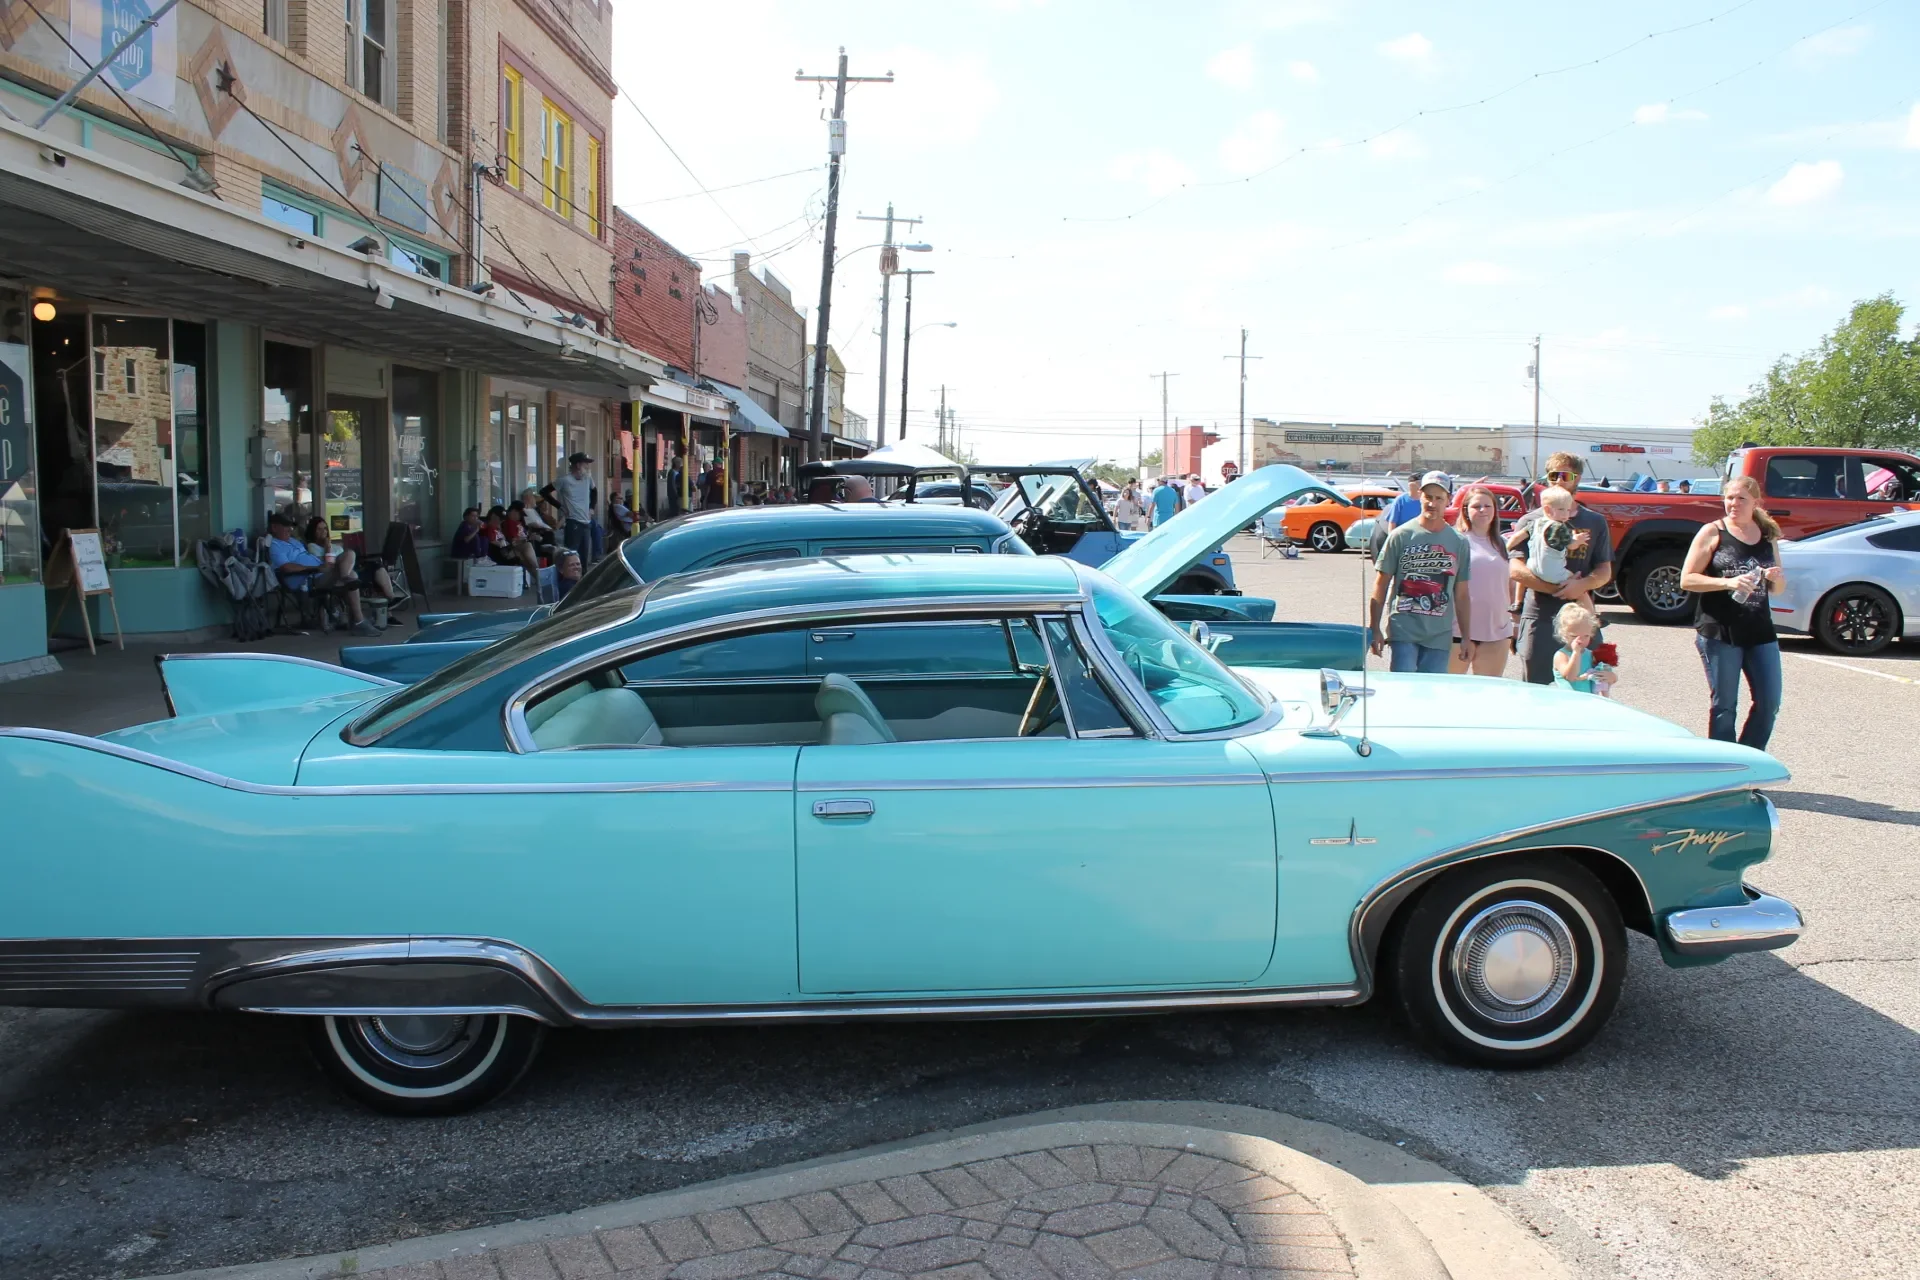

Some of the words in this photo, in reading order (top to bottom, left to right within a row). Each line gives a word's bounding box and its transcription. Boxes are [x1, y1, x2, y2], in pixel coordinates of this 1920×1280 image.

[1312, 434, 1332, 442] COUNTY
[1404, 544, 1430, 555] 2024
[1400, 551, 1445, 562] Cruzin
[1402, 560, 1453, 570] Cruzers
[1654, 828, 1746, 855] Fury
